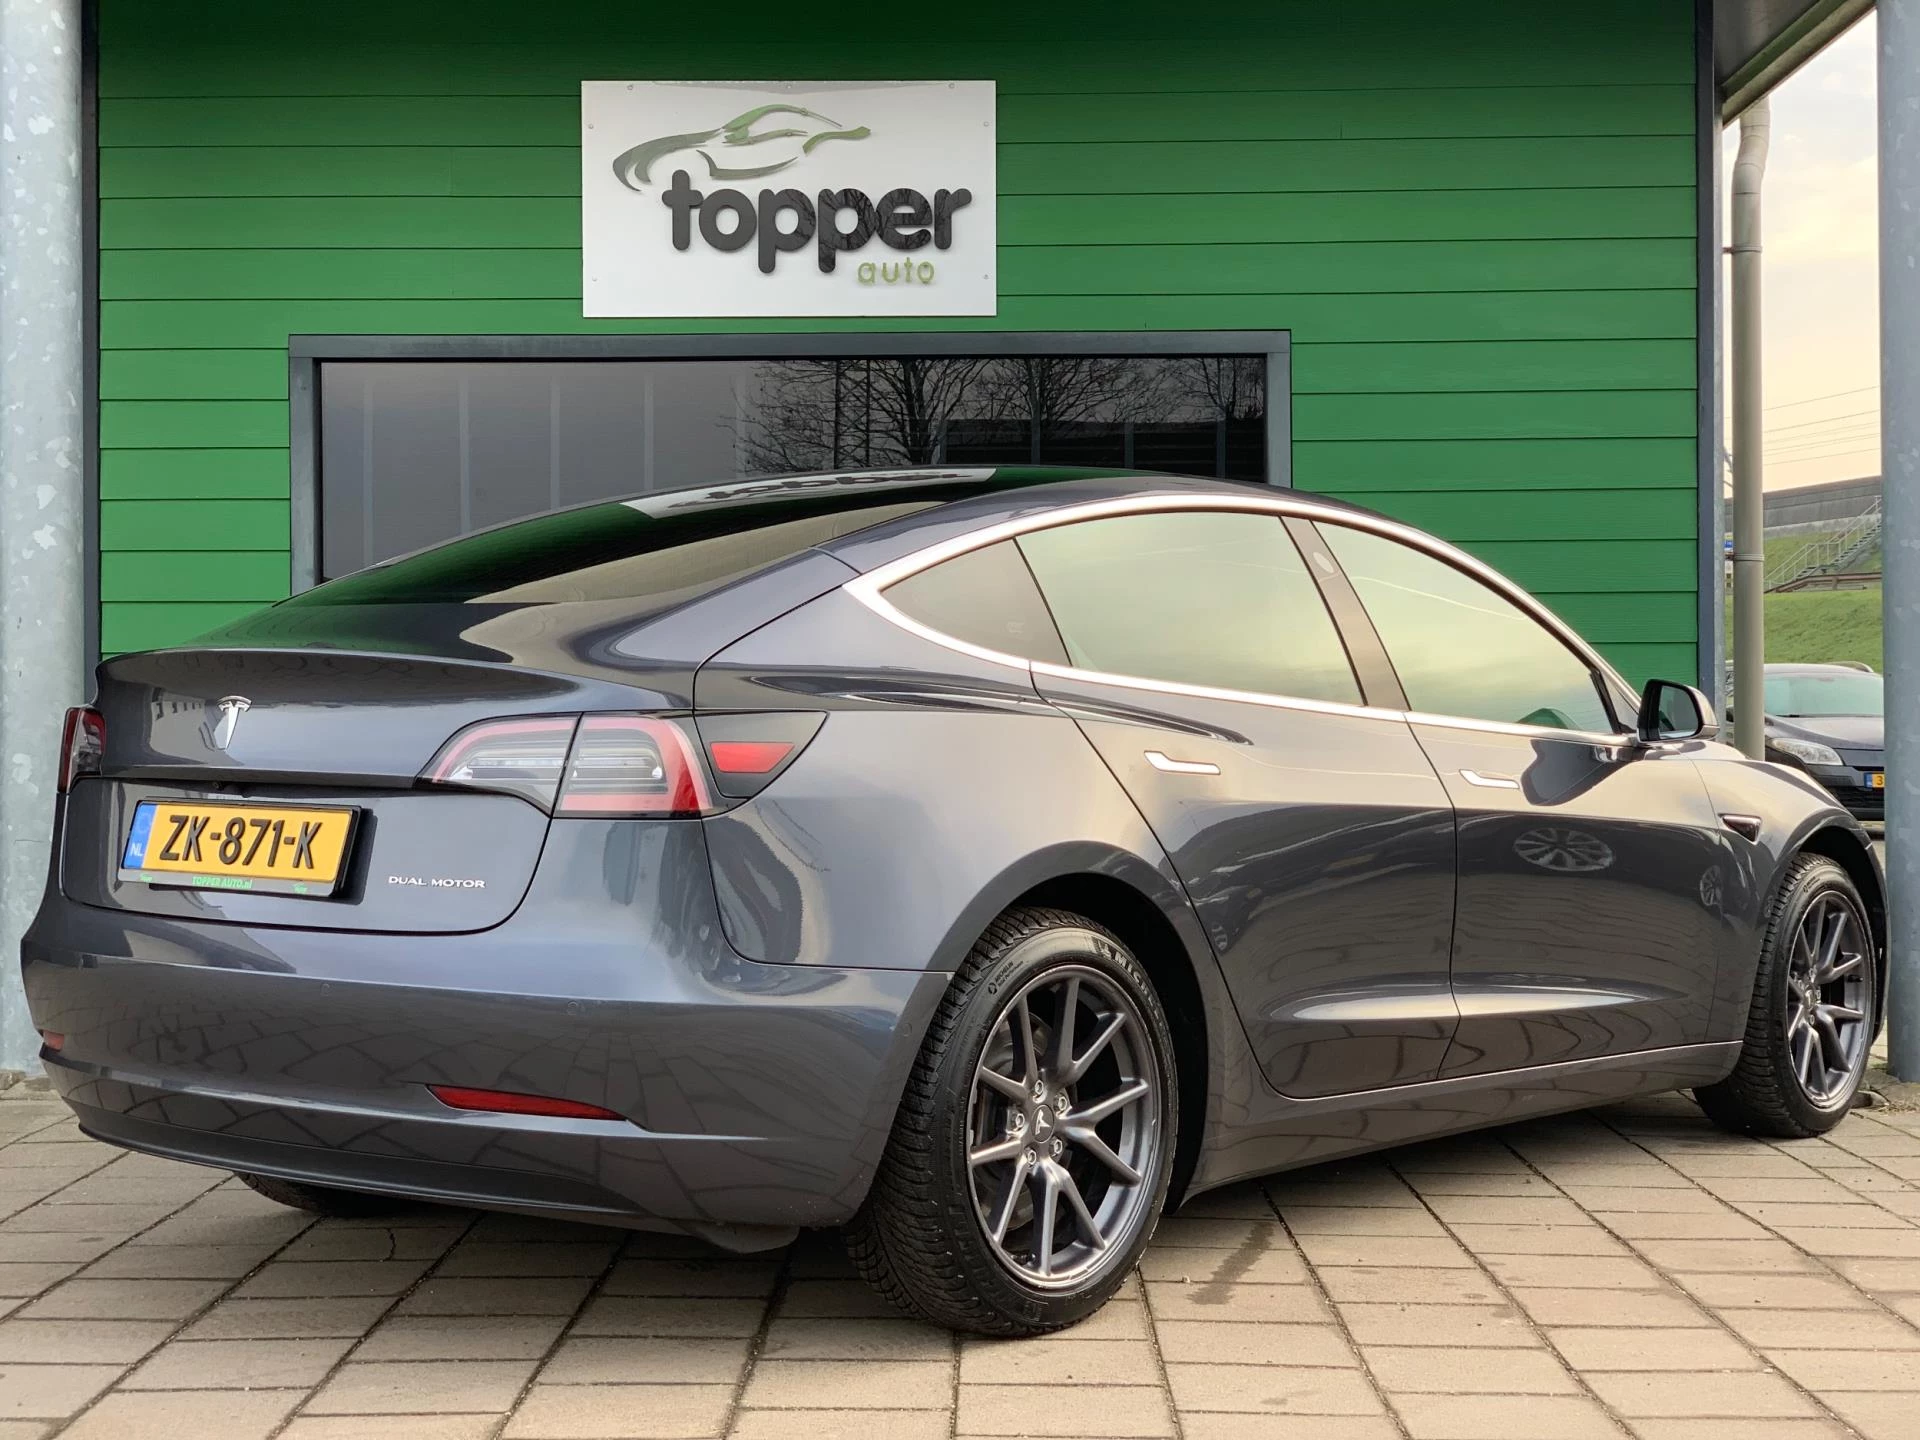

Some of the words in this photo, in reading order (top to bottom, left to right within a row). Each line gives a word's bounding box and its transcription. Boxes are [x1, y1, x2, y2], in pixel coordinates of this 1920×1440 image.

[662, 170, 972, 273] topper
[857, 256, 935, 284] auto
[131, 842, 143, 856] NL
[159, 814, 323, 869] ZK-871-K
[192, 876, 221, 886] TOPPER
[388, 876, 427, 886] DUAL
[431, 878, 486, 888] MOTOR
